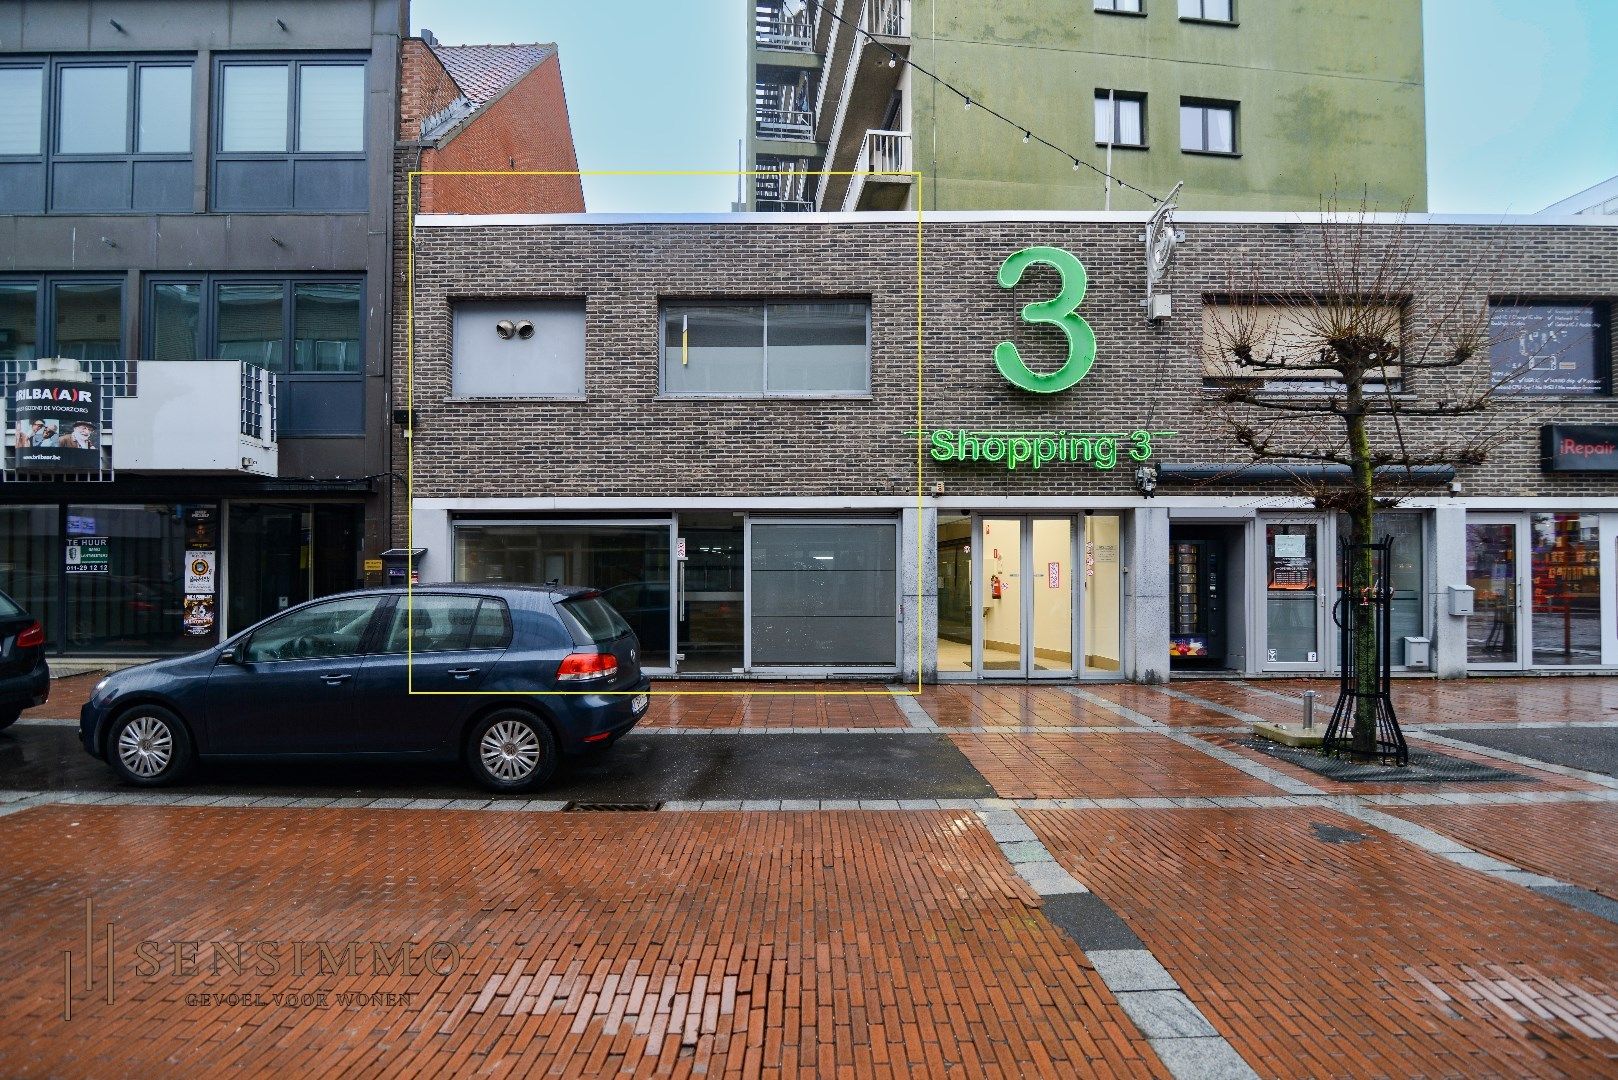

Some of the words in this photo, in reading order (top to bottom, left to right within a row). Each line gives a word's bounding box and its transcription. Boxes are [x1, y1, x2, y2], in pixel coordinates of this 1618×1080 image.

[994, 246, 1097, 393] 3
[51, 405, 89, 414] VOORZORG
[930, 429, 1117, 470] Shopping
[1129, 430, 1152, 461] 3
[1560, 438, 1616, 458] iRepair
